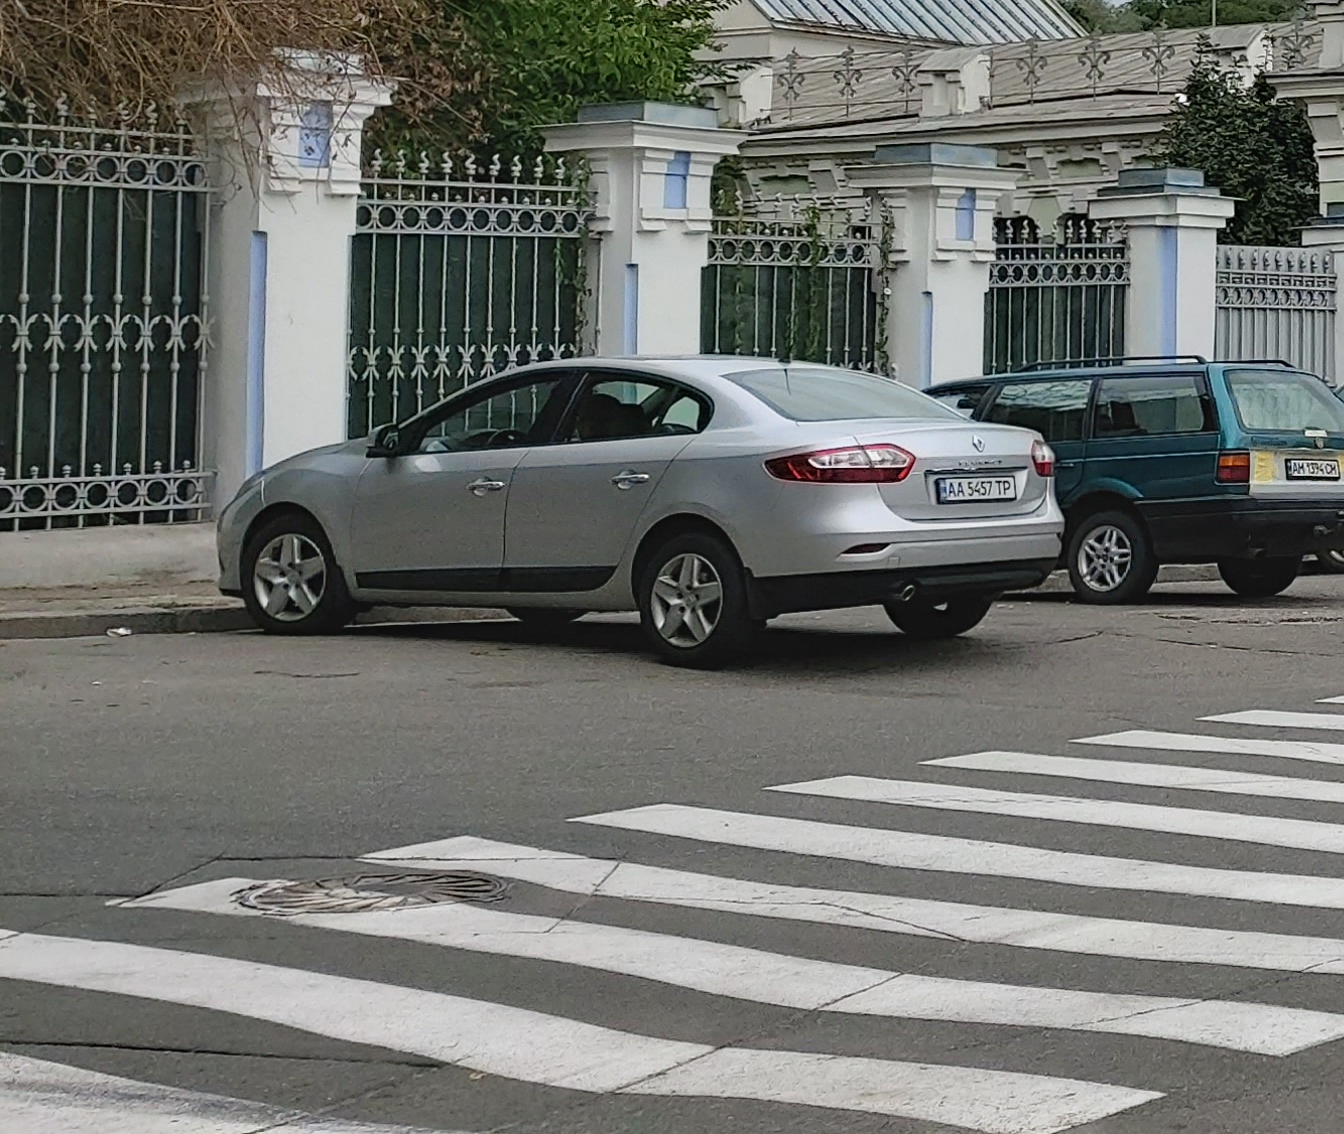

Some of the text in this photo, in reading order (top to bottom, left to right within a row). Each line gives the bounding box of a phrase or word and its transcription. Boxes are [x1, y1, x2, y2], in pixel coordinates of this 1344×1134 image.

[948, 479, 1011, 498] AA 5457 TP
